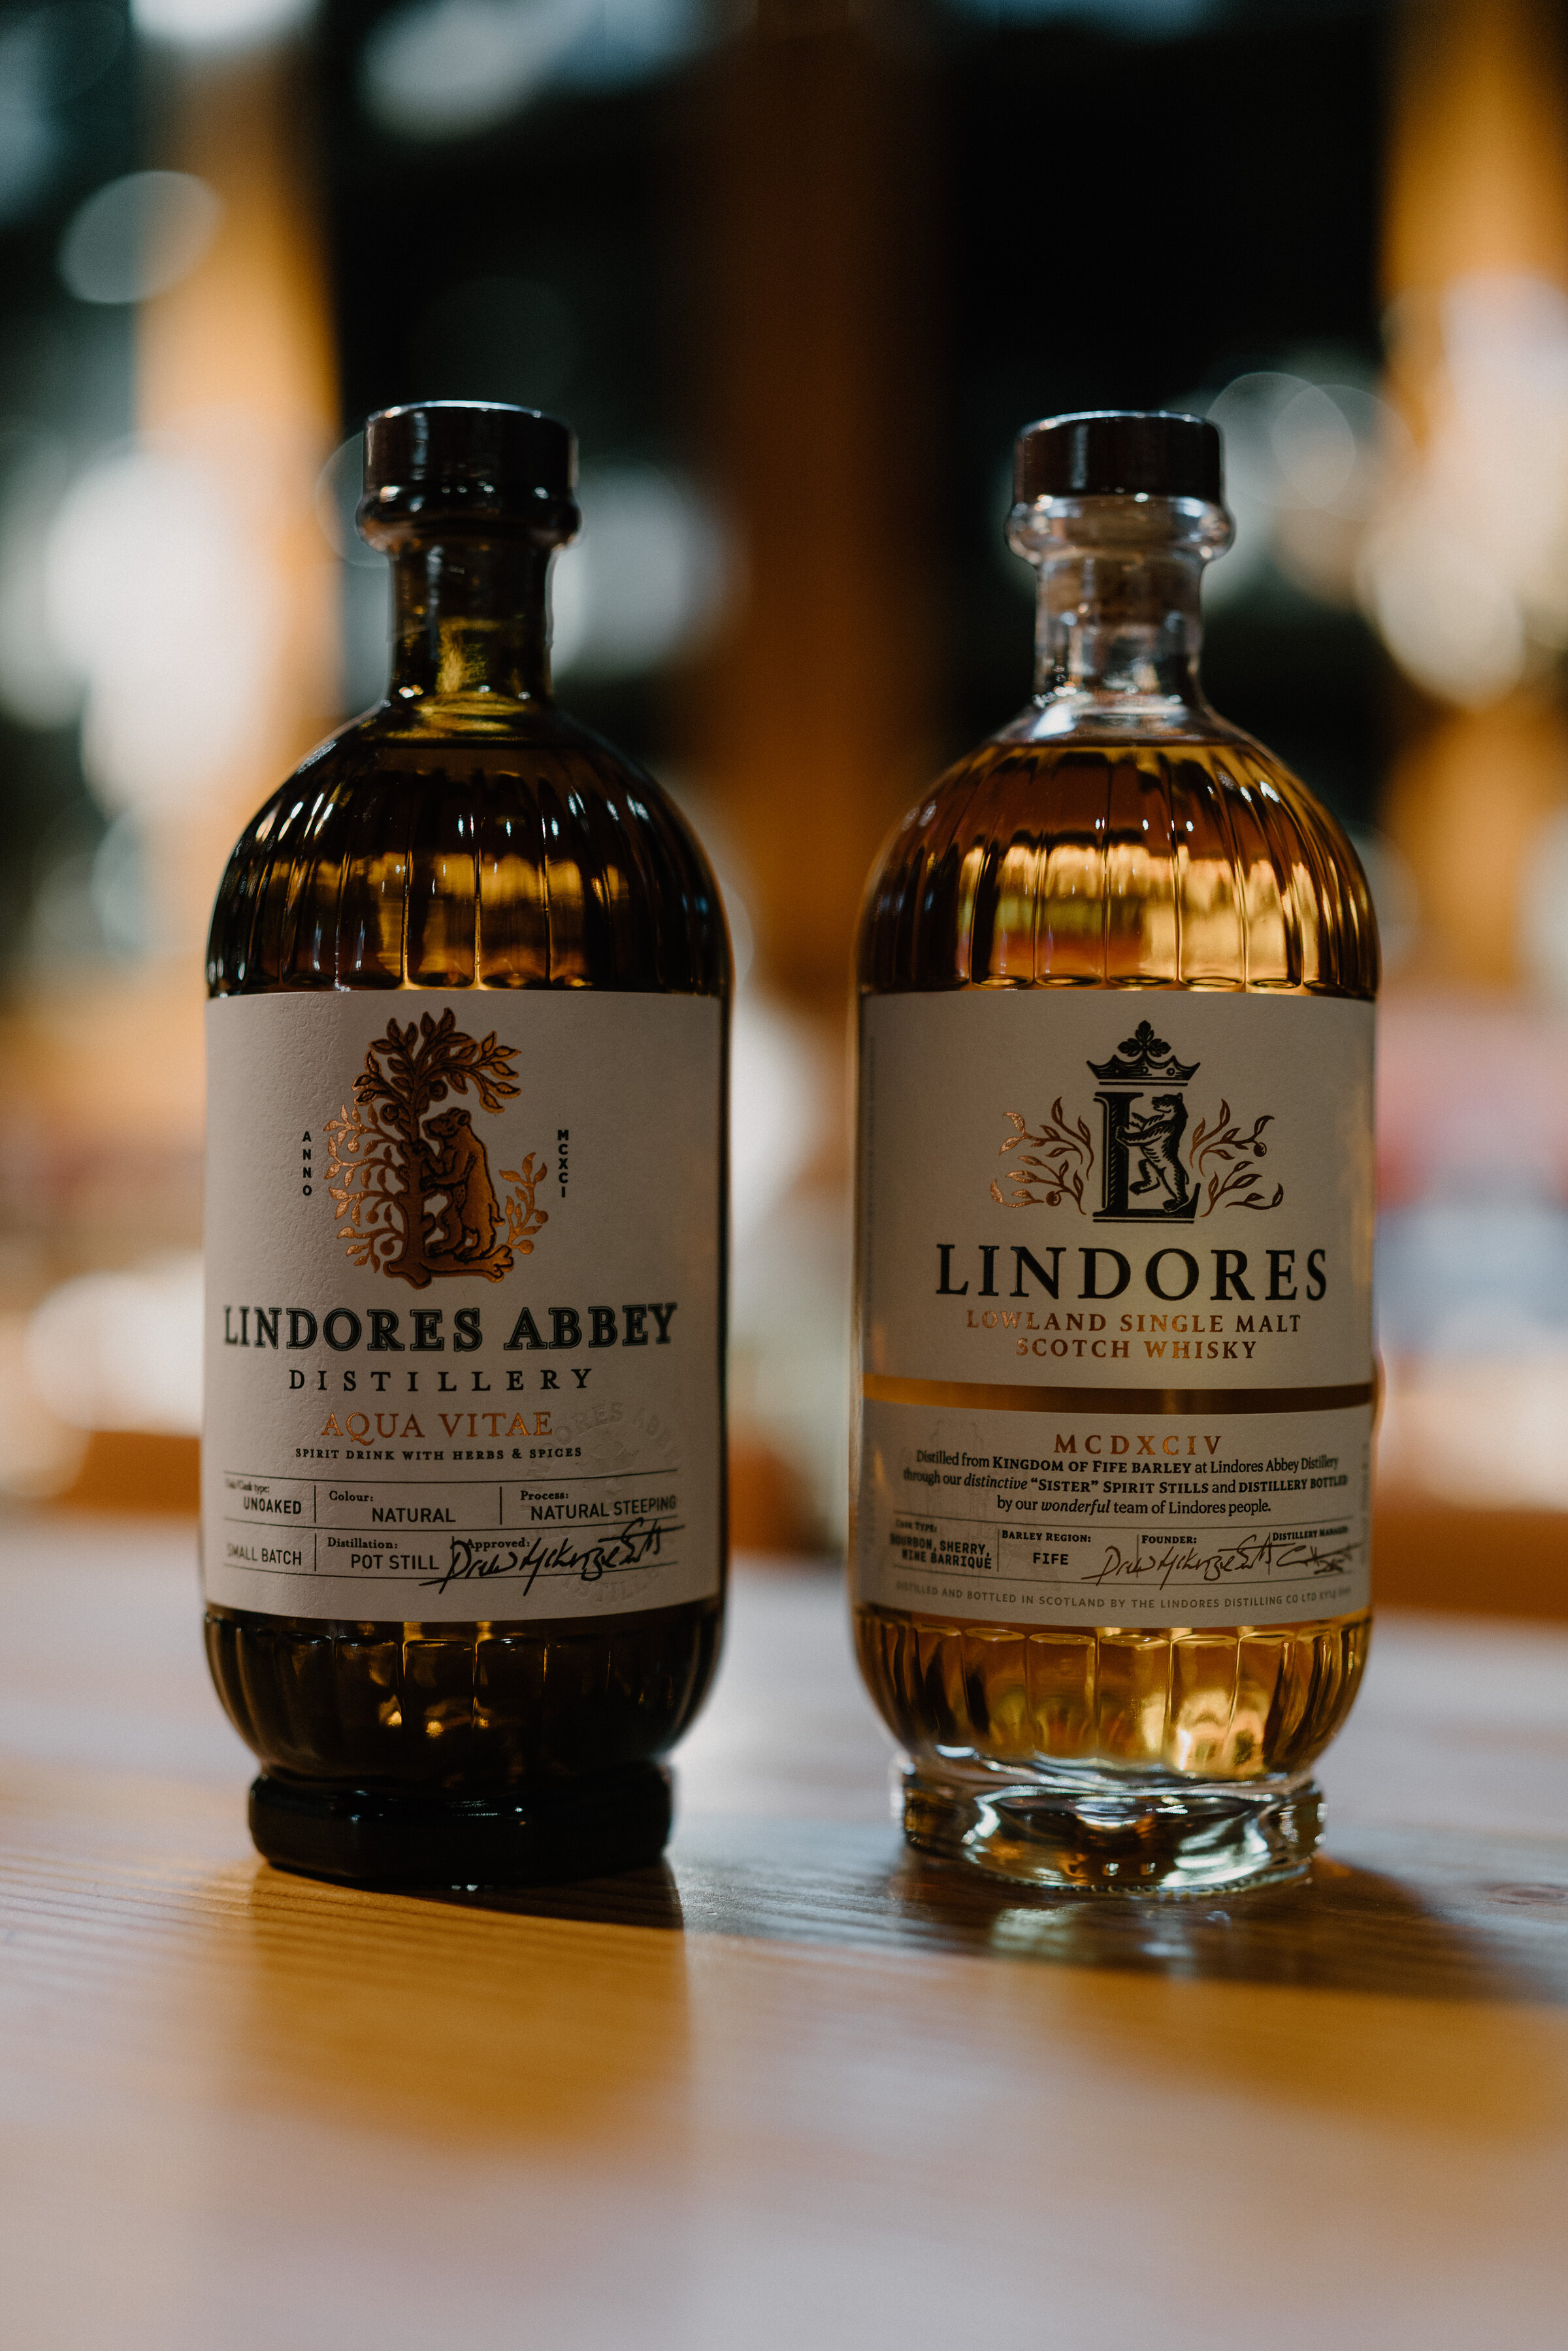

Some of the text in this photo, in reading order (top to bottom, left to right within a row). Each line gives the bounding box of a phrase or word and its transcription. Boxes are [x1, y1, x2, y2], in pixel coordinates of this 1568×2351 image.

[302, 1131, 312, 1196] ANNO
[557, 1130, 569, 1198] MCXCI
[936, 1243, 1328, 1302] LINDORES
[223, 1302, 678, 1352] LINDORES ABBEY
[966, 1309, 1301, 1333] LOWLAND SINGLE MALT
[1016, 1338, 1258, 1360] SCOTCH WHISKY
[289, 1368, 592, 1392] DISTILLERY
[321, 1411, 552, 1446] AQUA VITAE
[295, 1447, 582, 1460] SPIRIT DRINK WITH HERBS & SPICES
[1054, 1434, 1221, 1455] MCDXCIV
[916, 1450, 1339, 1474] Distilled from KINGDOM OF FIFE BARLEY at Lindores Abbey Distillery
[254, 1484, 270, 1496] type:
[904, 1468, 940, 1487] through
[943, 1473, 962, 1486] our
[964, 1473, 1028, 1490] distinctive
[1103, 1479, 1154, 1494] SPIRIT
[1159, 1481, 1209, 1494] STILLS
[1212, 1479, 1236, 1494] and
[1239, 1479, 1308, 1493] DISTILLERY
[1310, 1474, 1348, 1490] BOTTLED
[244, 1496, 302, 1515] UNOAKED
[329, 1490, 373, 1502] Colour:
[520, 1490, 568, 1501] Process:
[997, 1495, 1271, 1517] by our wonderful team of Lindores people.
[372, 1507, 456, 1522] NATURAL
[531, 1495, 676, 1521] NATURAL STEEPING
[327, 1537, 398, 1549] Distillation:
[466, 1537, 530, 1552] Approved:
[1002, 1530, 1091, 1543] BARLEY REGION:
[1141, 1535, 1197, 1544] FOUNDER:
[1273, 1530, 1317, 1541] DISTILLERY
[227, 1543, 302, 1566] SMALL BATCH
[939, 1540, 990, 1557] SHERRY,
[1033, 1552, 1068, 1565] FIFE
[351, 1554, 439, 1570] POT STILL
[902, 1549, 992, 1570] WINE BARRIQUE
[896, 1581, 938, 1595] DISTILLED
[942, 1588, 962, 1598] AND
[967, 1590, 1016, 1603] BOTTLED
[1022, 1595, 1034, 1604] IN
[1039, 1596, 1105, 1607] SCOTLAND
[1111, 1598, 1126, 1607] BY
[1131, 1599, 1154, 1608] THE
[1160, 1599, 1219, 1608] LINDORES
[1224, 1595, 1282, 1607] DISTILLING
[1286, 1594, 1299, 1604] CO
[1301, 1592, 1316, 1603] LTD
